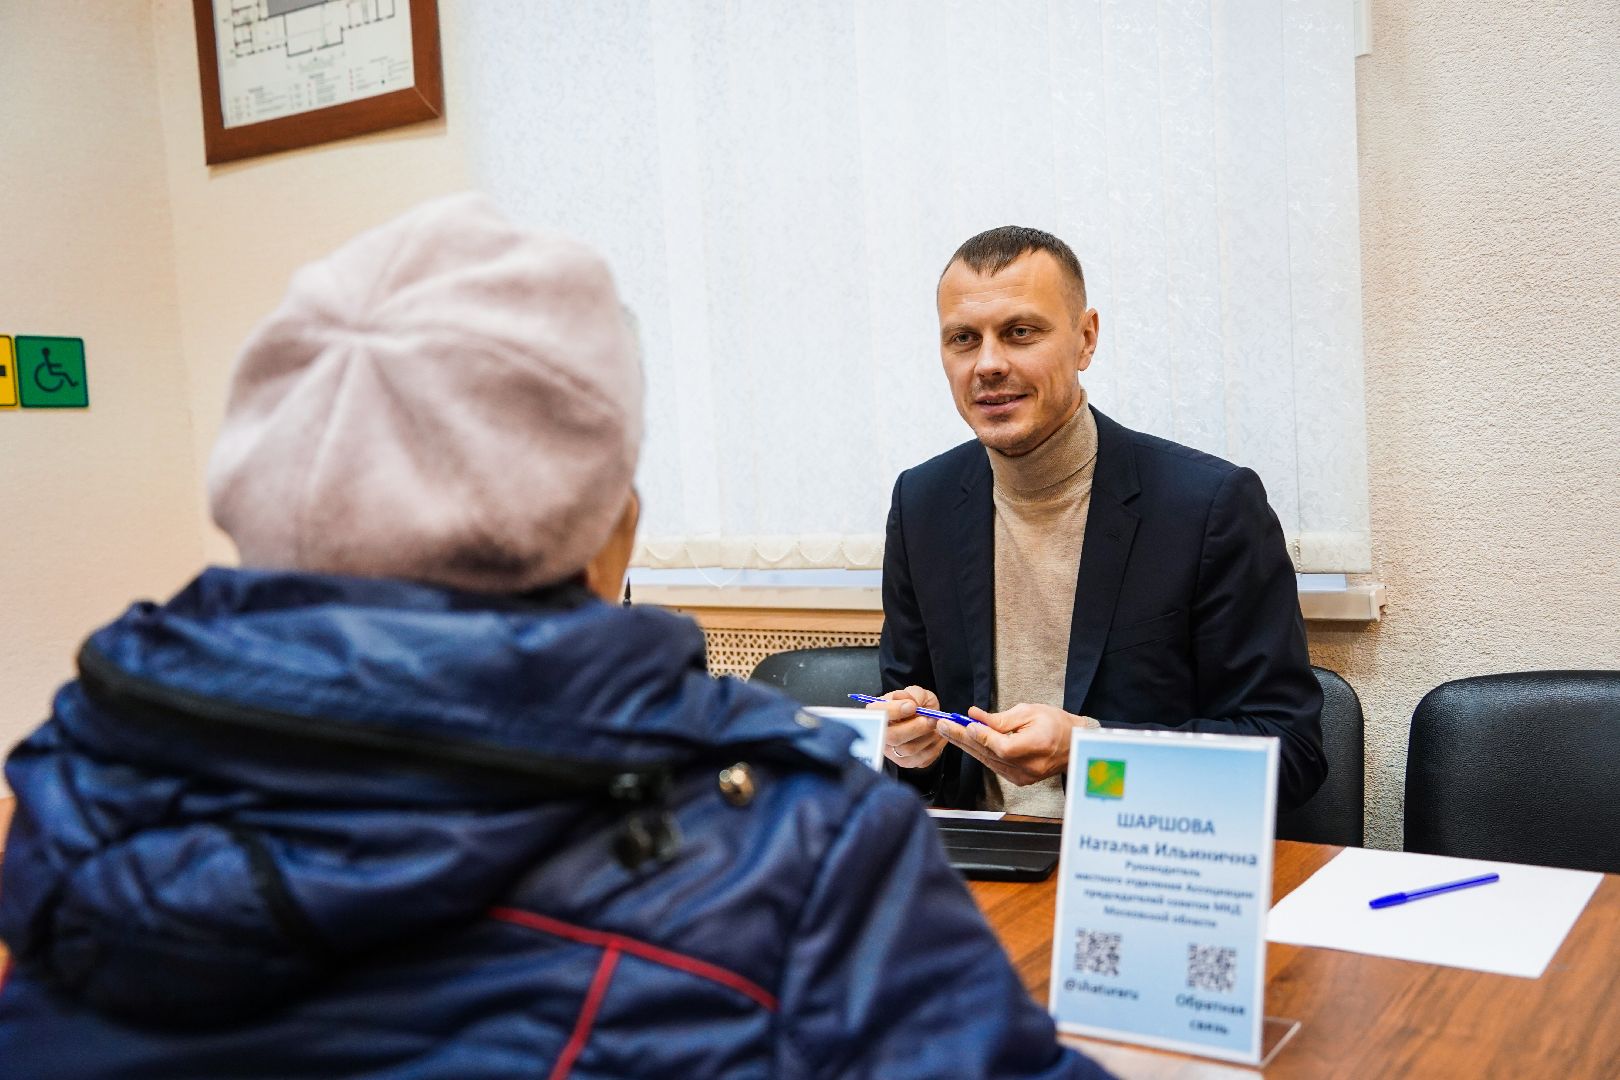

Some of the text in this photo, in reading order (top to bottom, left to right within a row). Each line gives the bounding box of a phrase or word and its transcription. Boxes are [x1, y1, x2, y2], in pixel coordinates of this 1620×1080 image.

[1117, 812, 1215, 834] ШАРШОВА
[1079, 835, 1257, 866] Наталья Ильинична
[1175, 993, 1246, 1016] Обратная
[1189, 1019, 1229, 1035] связь
